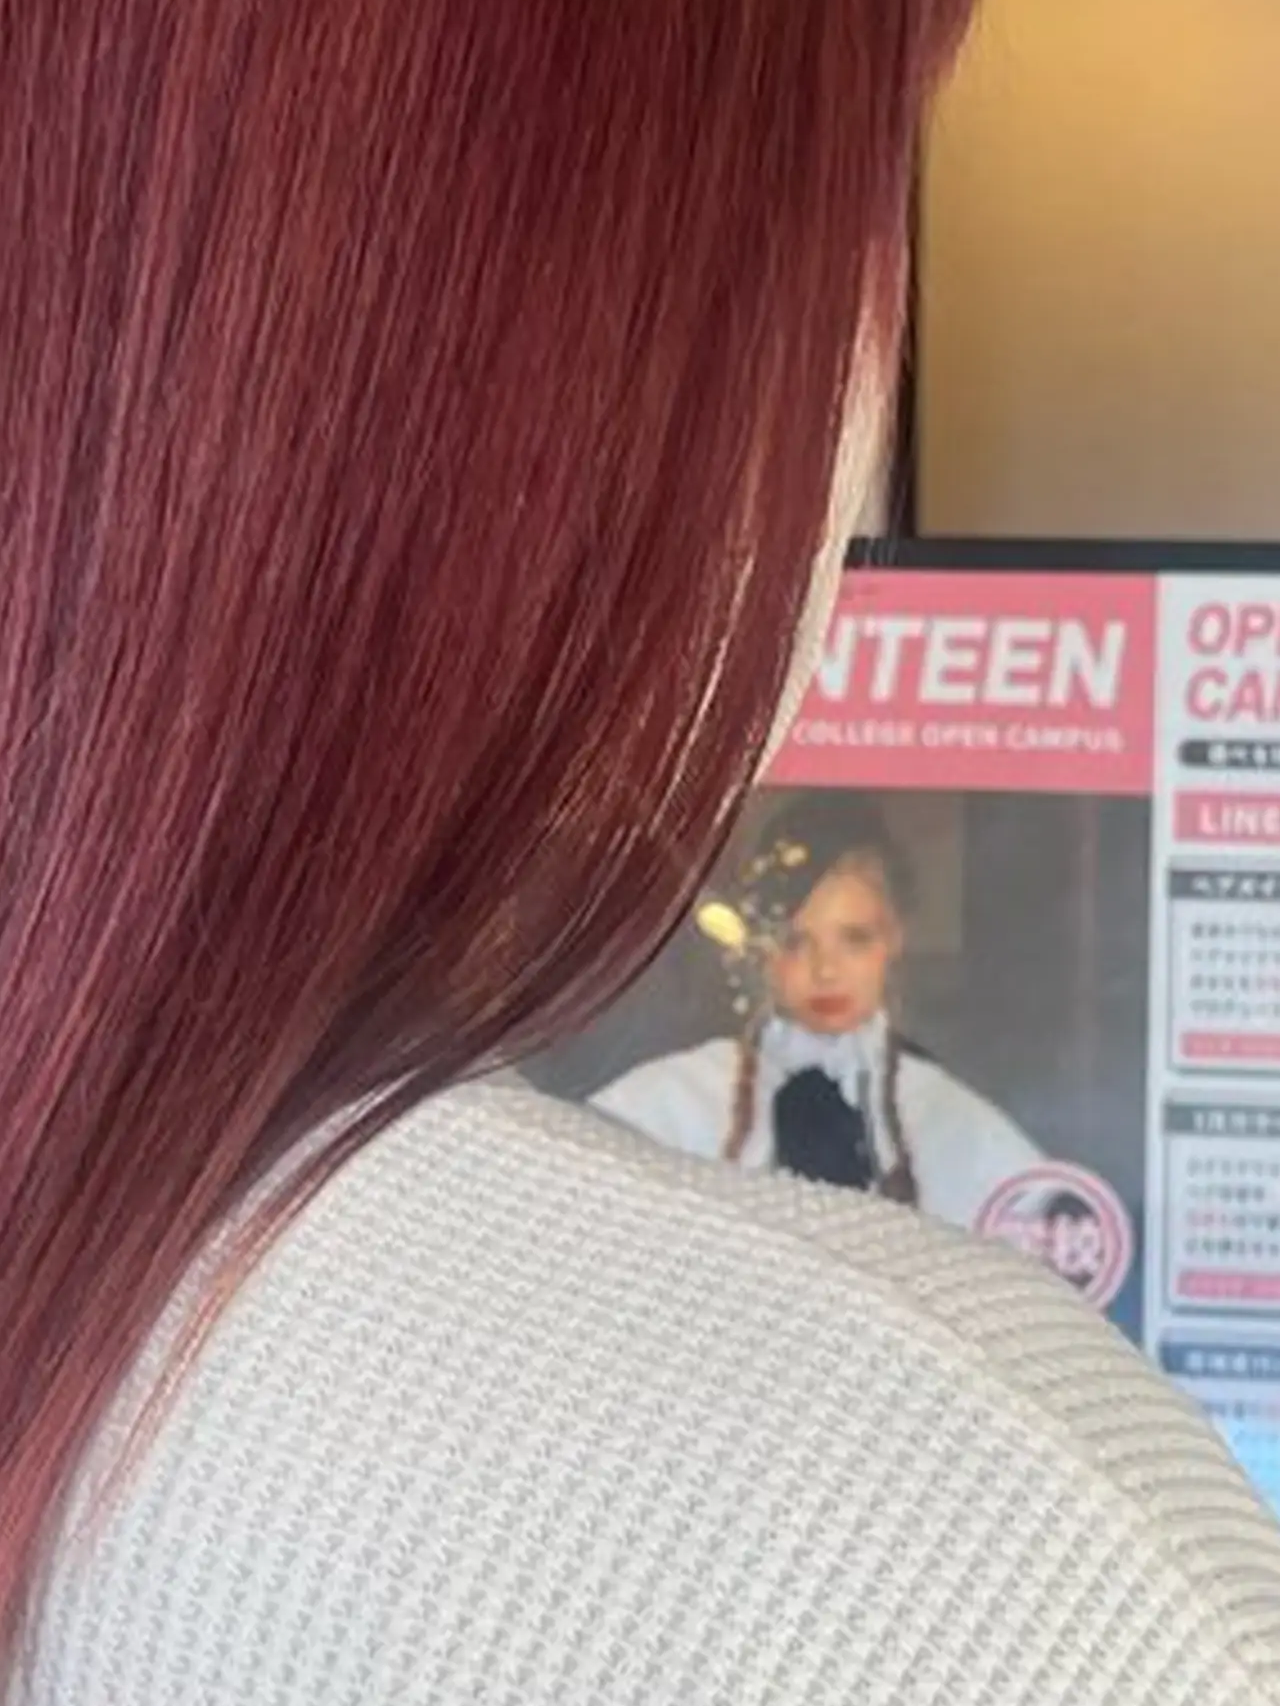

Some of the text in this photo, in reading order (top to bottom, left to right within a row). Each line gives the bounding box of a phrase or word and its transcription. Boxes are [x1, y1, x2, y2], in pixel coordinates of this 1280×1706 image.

[792, 720, 1126, 754] COLLEGE OPEN CAMPUS
